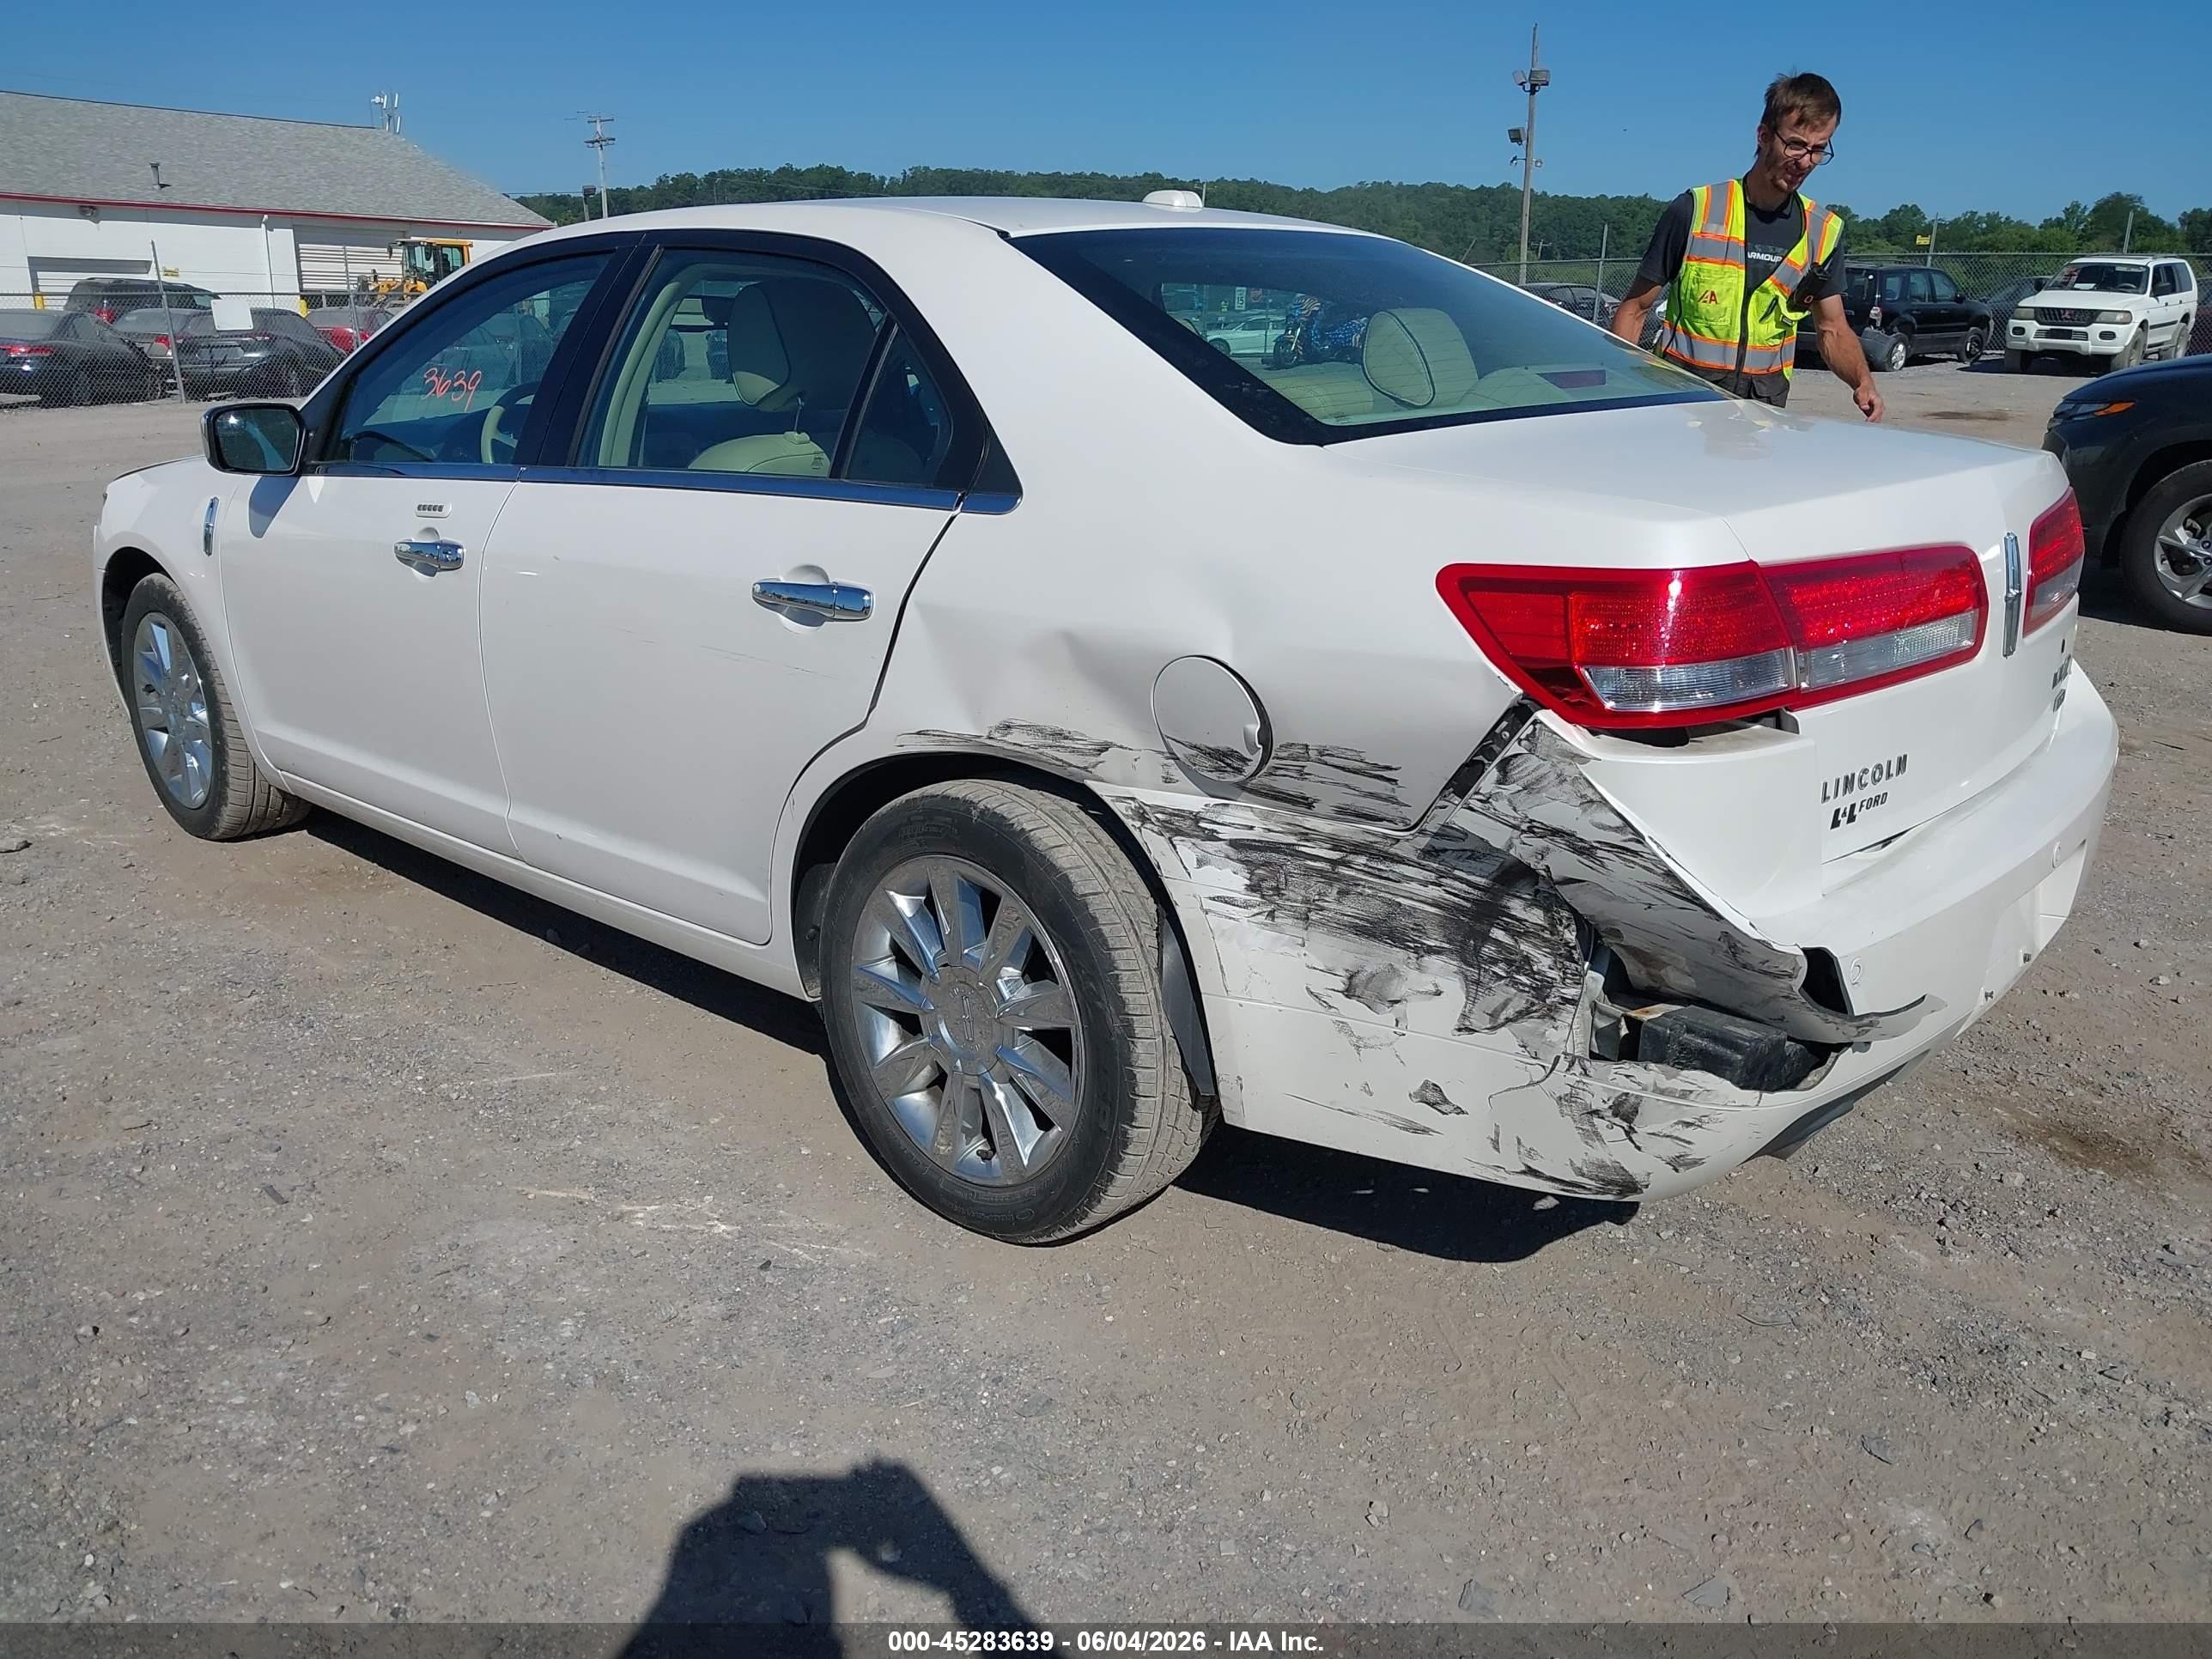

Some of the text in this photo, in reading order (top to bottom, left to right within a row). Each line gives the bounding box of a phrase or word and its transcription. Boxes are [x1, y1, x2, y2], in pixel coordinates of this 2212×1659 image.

[422, 367, 483, 413] 3639
[1820, 753, 1908, 805] LINCOLN
[1830, 792, 1888, 830] L&L FORD
